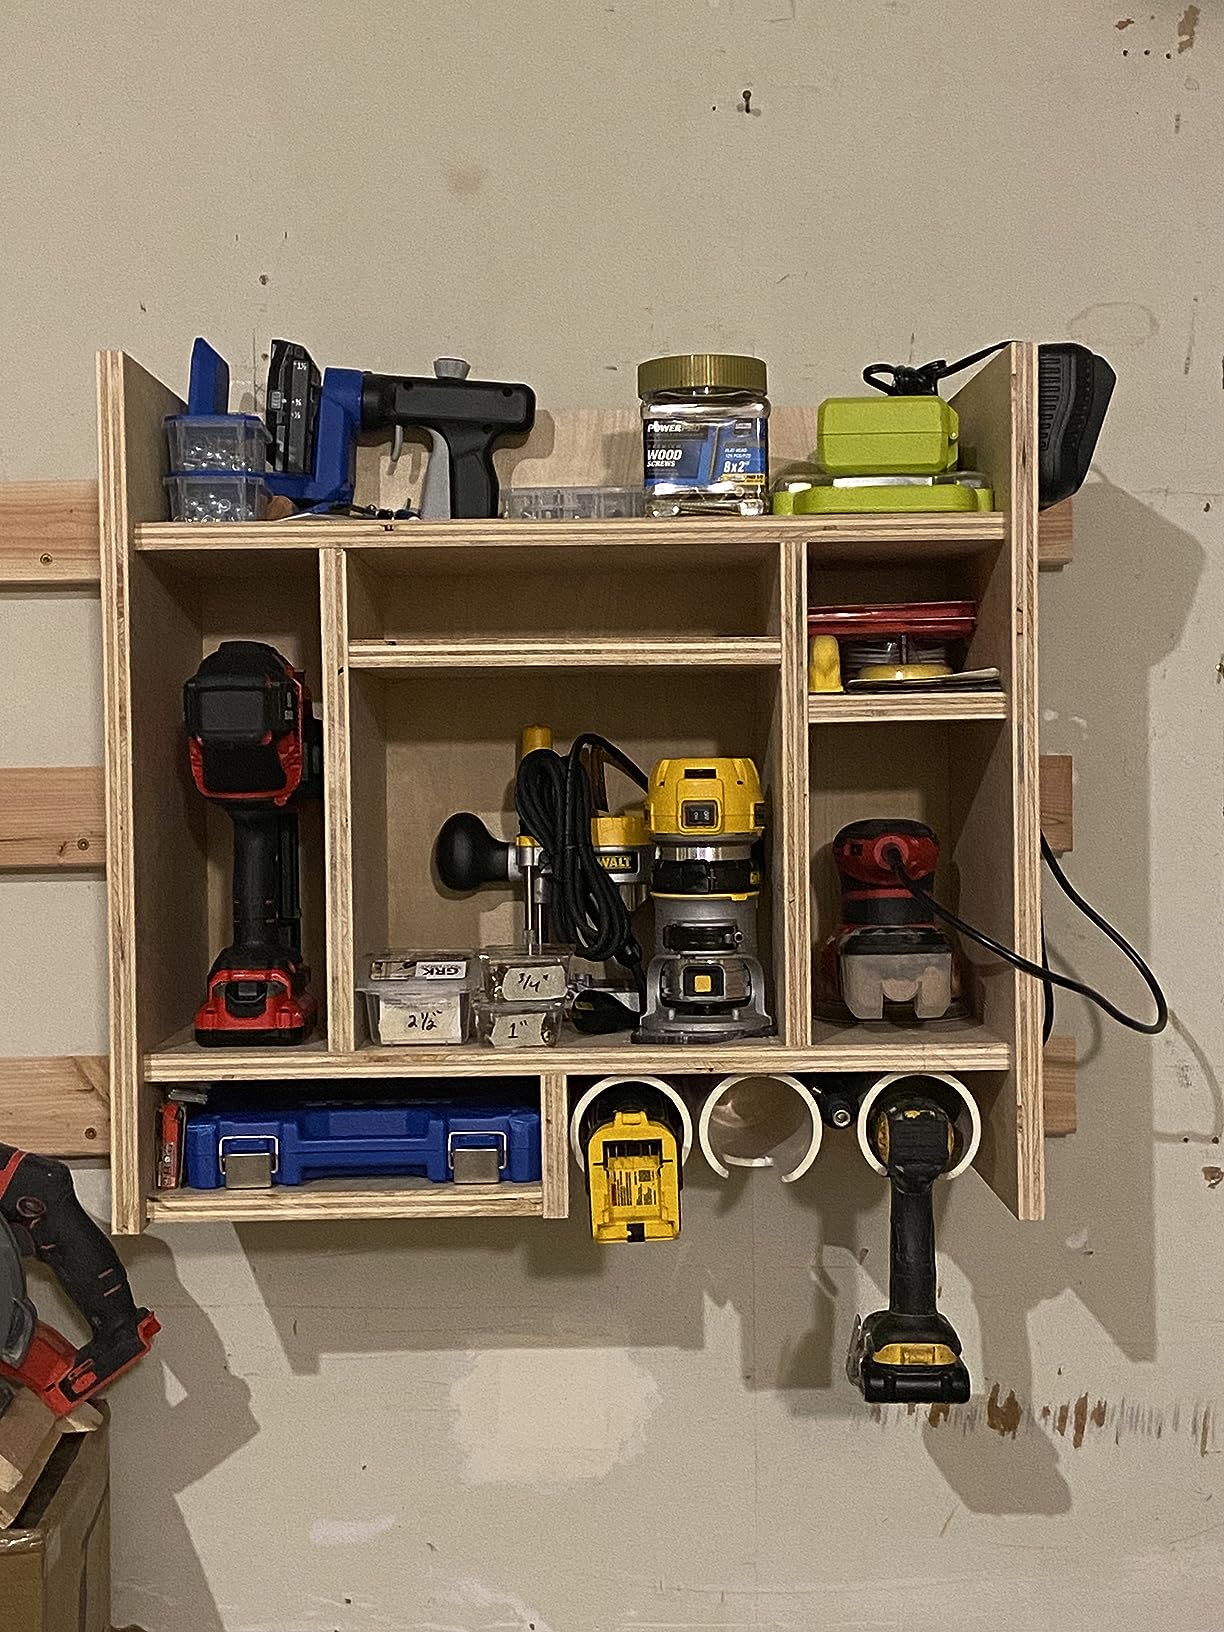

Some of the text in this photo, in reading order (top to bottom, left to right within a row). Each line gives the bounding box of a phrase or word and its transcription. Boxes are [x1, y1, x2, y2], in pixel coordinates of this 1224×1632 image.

[647, 449, 683, 461] WOOD
[646, 460, 676, 468] SCREWS
[422, 966, 459, 977] GRK
